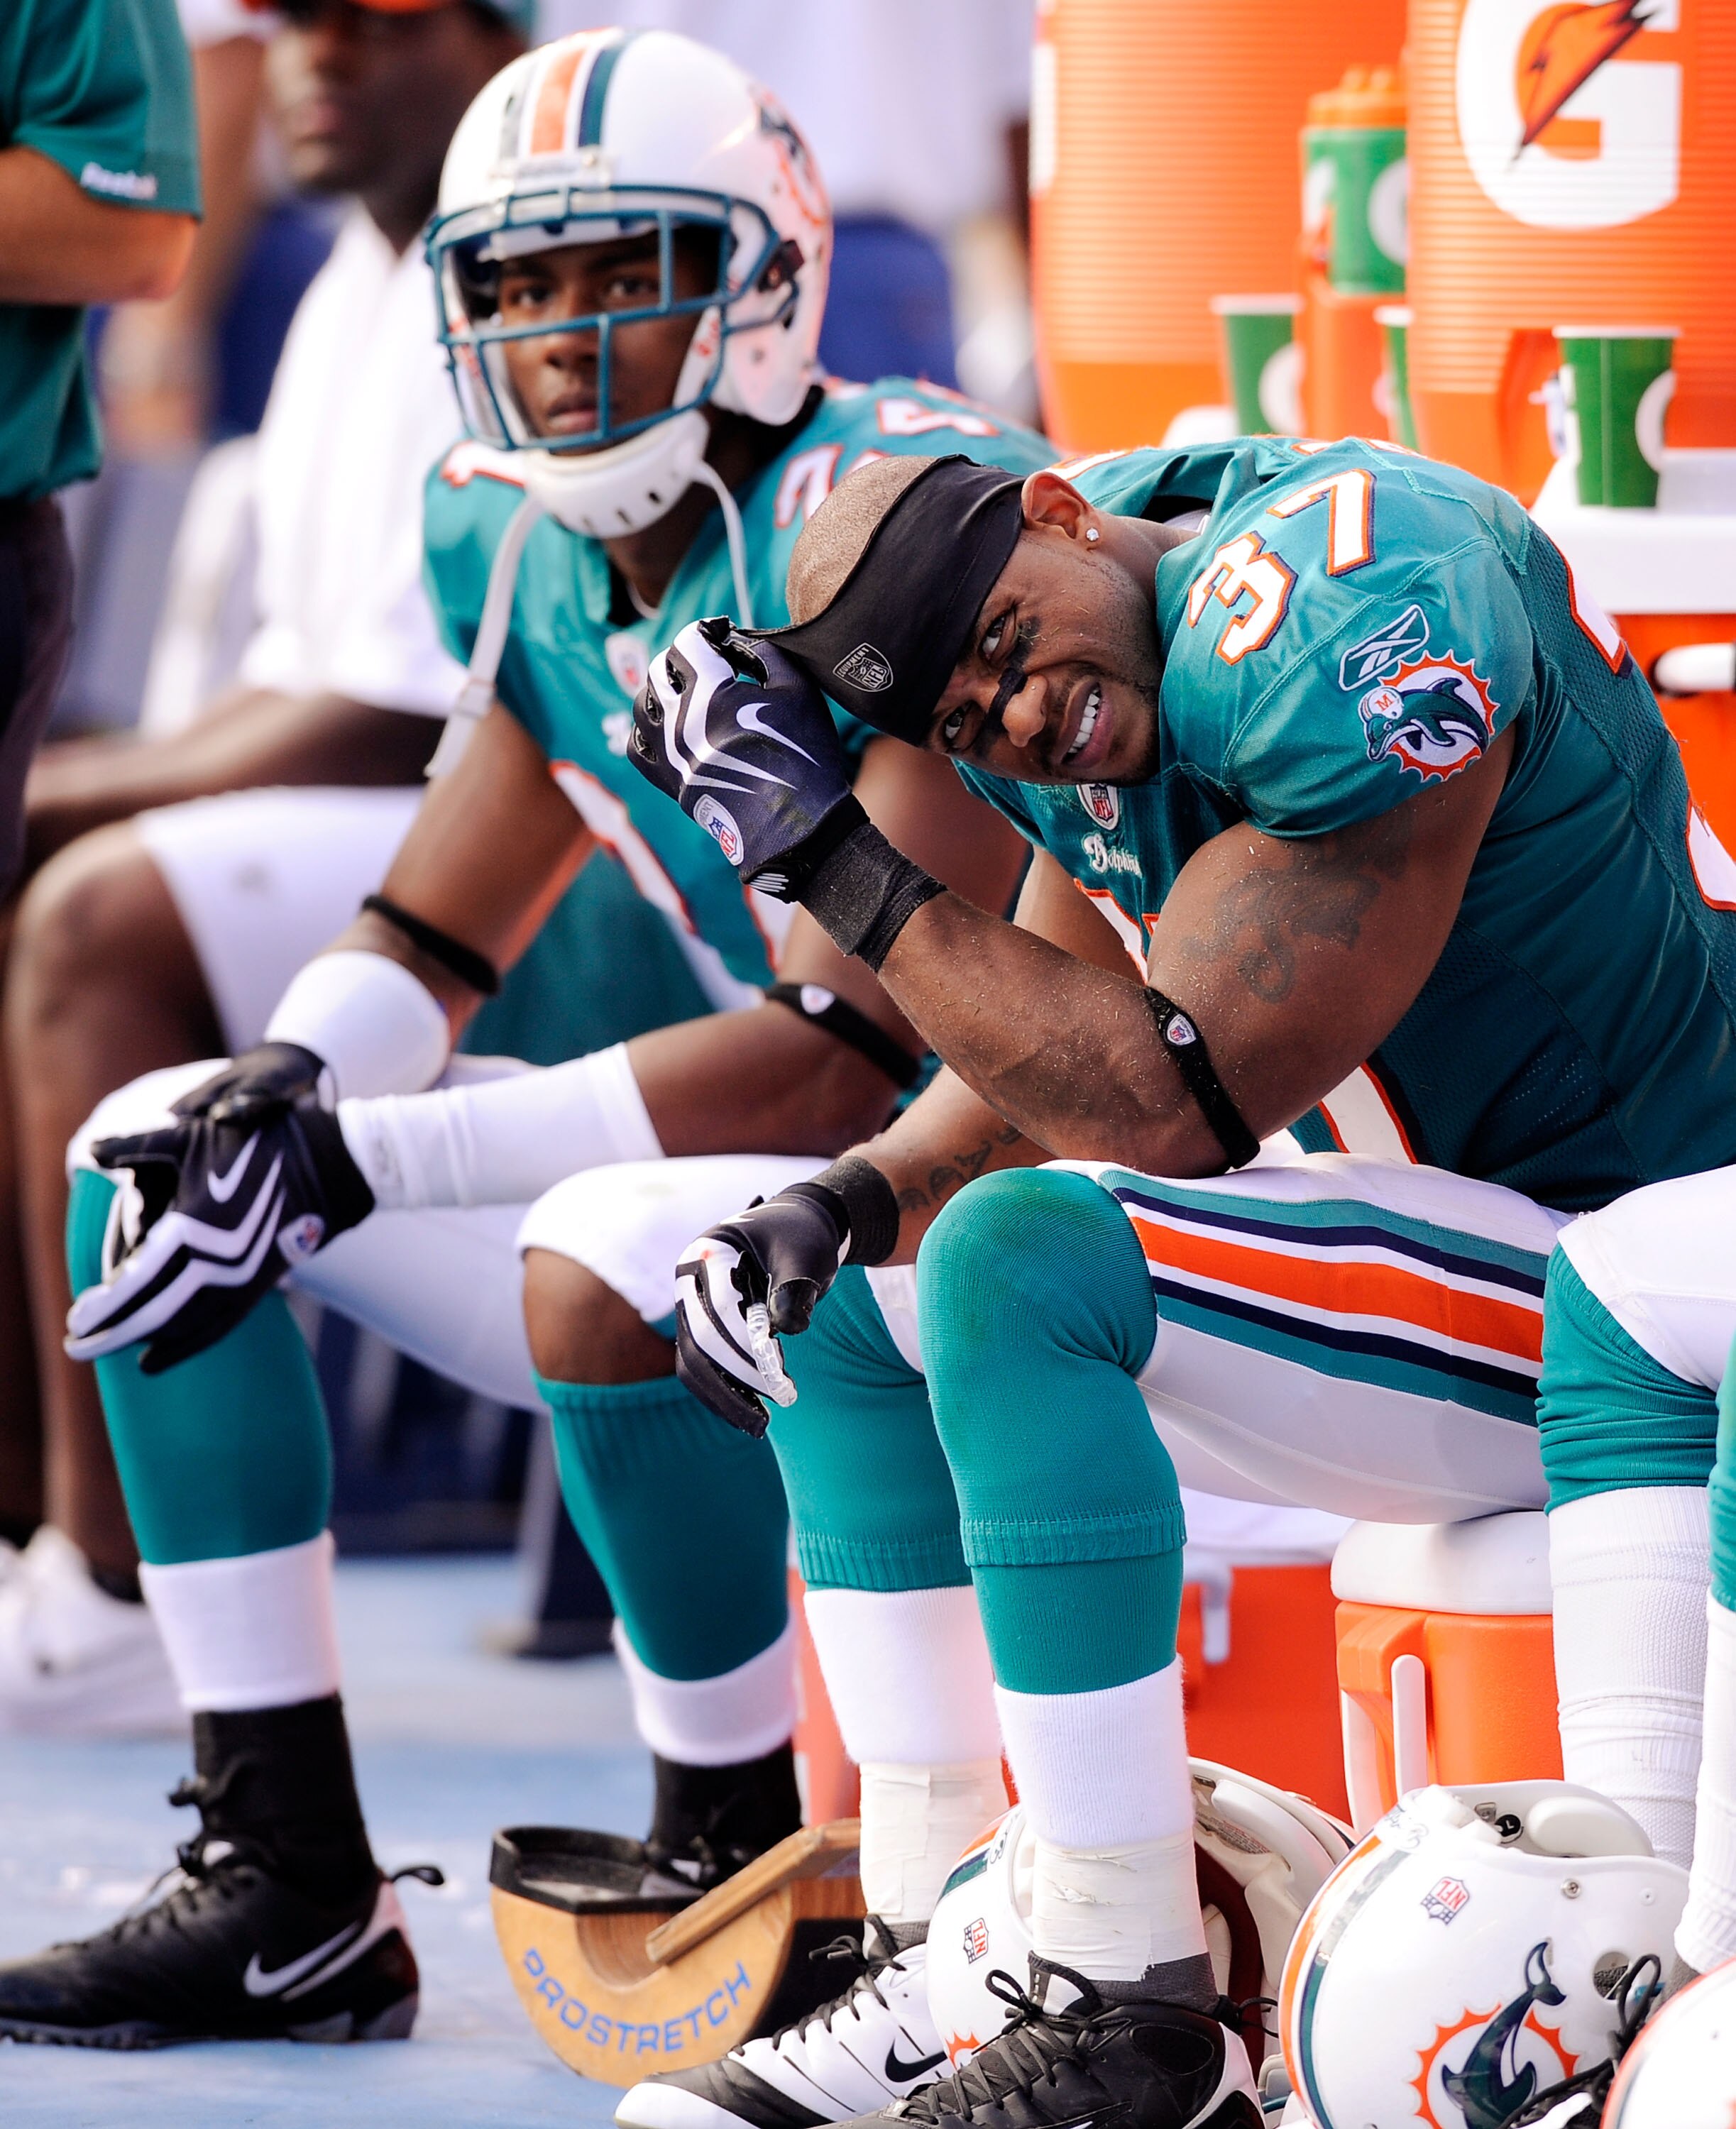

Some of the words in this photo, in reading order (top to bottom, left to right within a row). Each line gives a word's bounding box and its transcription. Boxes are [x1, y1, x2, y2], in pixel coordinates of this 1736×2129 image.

[1455, 0, 1682, 229] G
[1187, 468, 1377, 666] 37
[836, 646, 870, 678] EQUIPMENT
[862, 664, 886, 688] NFL
[1375, 693, 1395, 712] M
[1436, 1880, 1466, 1910] NFL
[972, 1920, 987, 1956] NFL
[522, 1947, 753, 2054] PROSTRETCH
